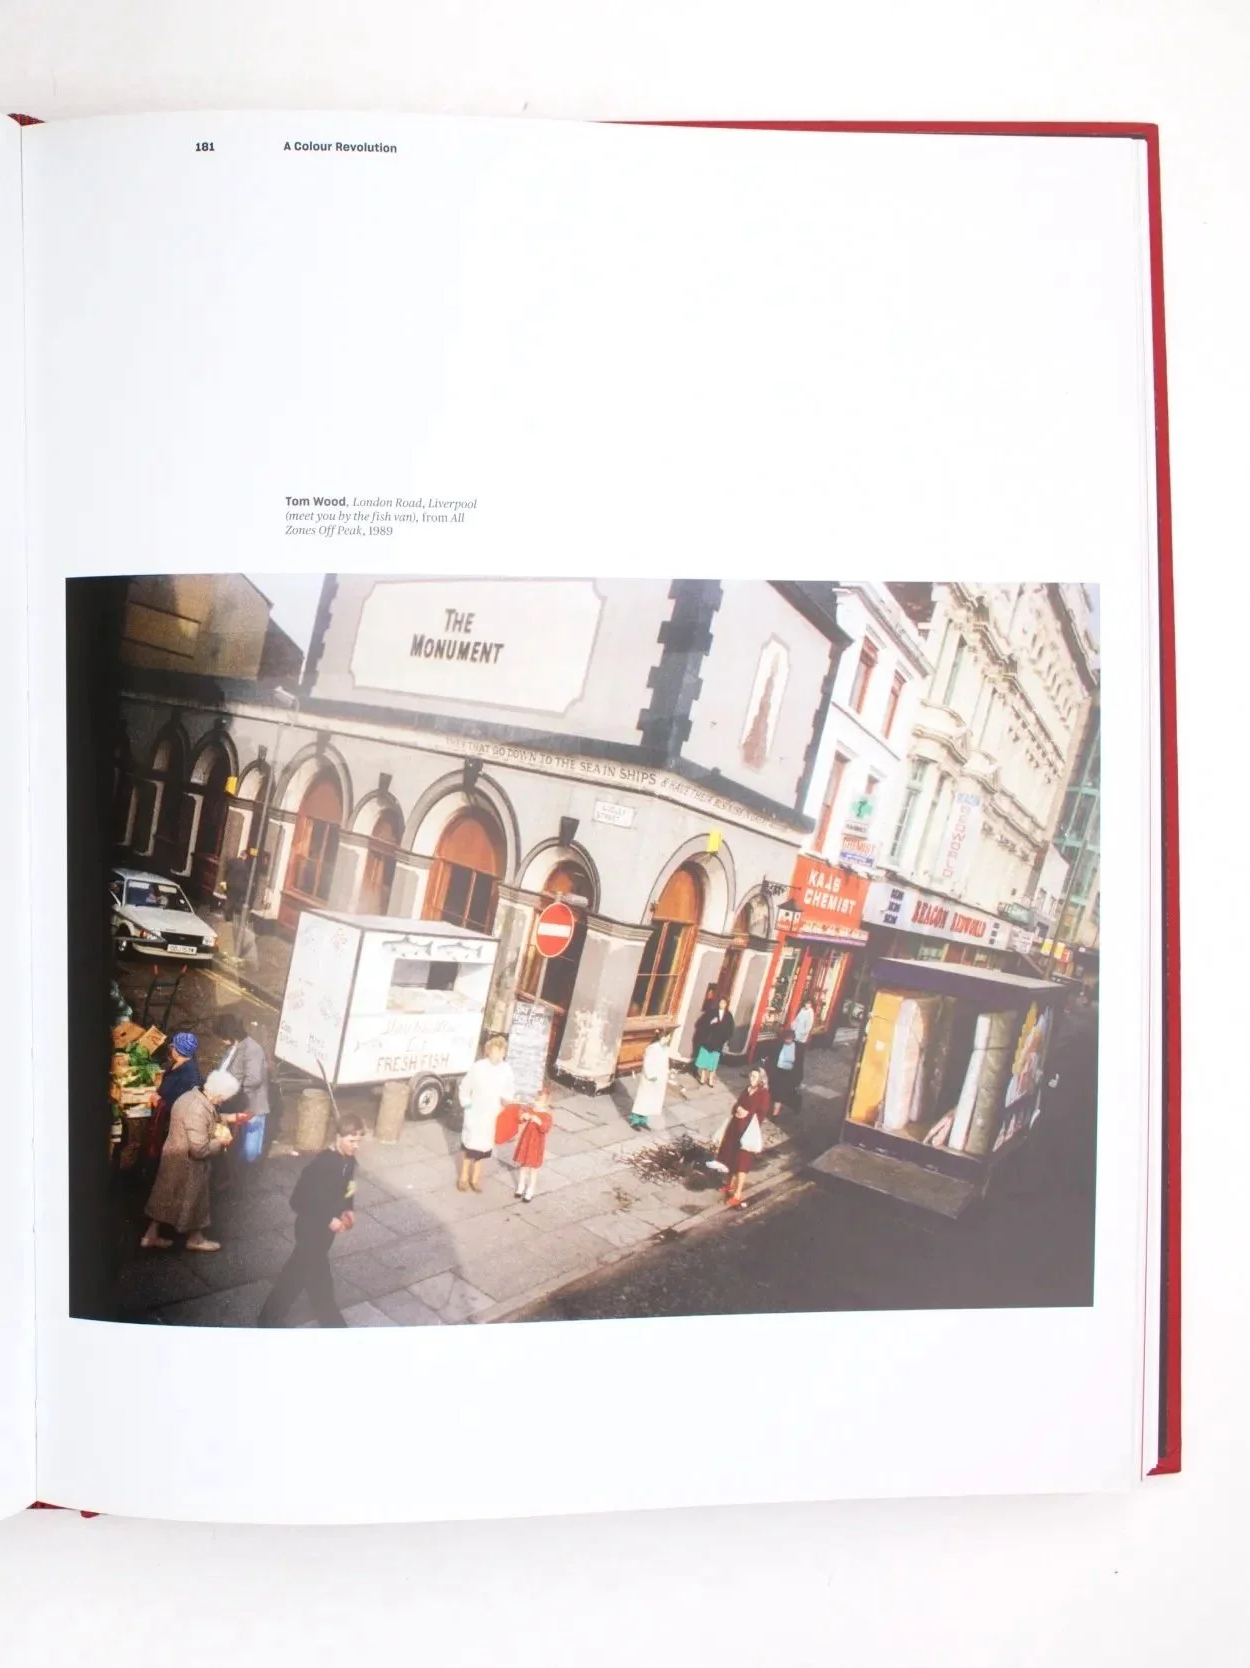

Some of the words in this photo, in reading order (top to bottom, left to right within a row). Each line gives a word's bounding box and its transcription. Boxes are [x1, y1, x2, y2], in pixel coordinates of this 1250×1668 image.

[196, 142, 214, 152] 181
[284, 142, 291, 151] A
[294, 141, 332, 151] Colour
[336, 142, 397, 153] Revolution
[286, 497, 310, 506] Tom
[313, 497, 349, 507] Wood,
[353, 497, 392, 507] London
[396, 498, 425, 509] Road,
[429, 499, 477, 511] Liverpool
[286, 512, 314, 521] (meet
[316, 514, 335, 523] you
[339, 511, 351, 523] by
[354, 511, 369, 520] the
[370, 512, 391, 523] fish
[394, 514, 418, 522] van),
[423, 513, 447, 522] from
[451, 513, 464, 522] All
[286, 526, 316, 534] Zones
[319, 525, 336, 537] Off
[338, 525, 365, 535] Peak,
[370, 526, 393, 535] 1989
[444, 608, 476, 634] THE
[410, 634, 504, 664] MONUMENT
[492, 746, 506, 757] GO
[507, 748, 537, 762] DOWN
[540, 755, 553, 766] TO
[556, 757, 576, 770] THE
[580, 762, 601, 775] SEA
[601, 767, 616, 778] IN
[618, 769, 656, 786] SHIPS
[803, 893, 856, 914] CHEMIST
[376, 1056, 417, 1073] FRESH
[421, 1052, 450, 1070] FISH
